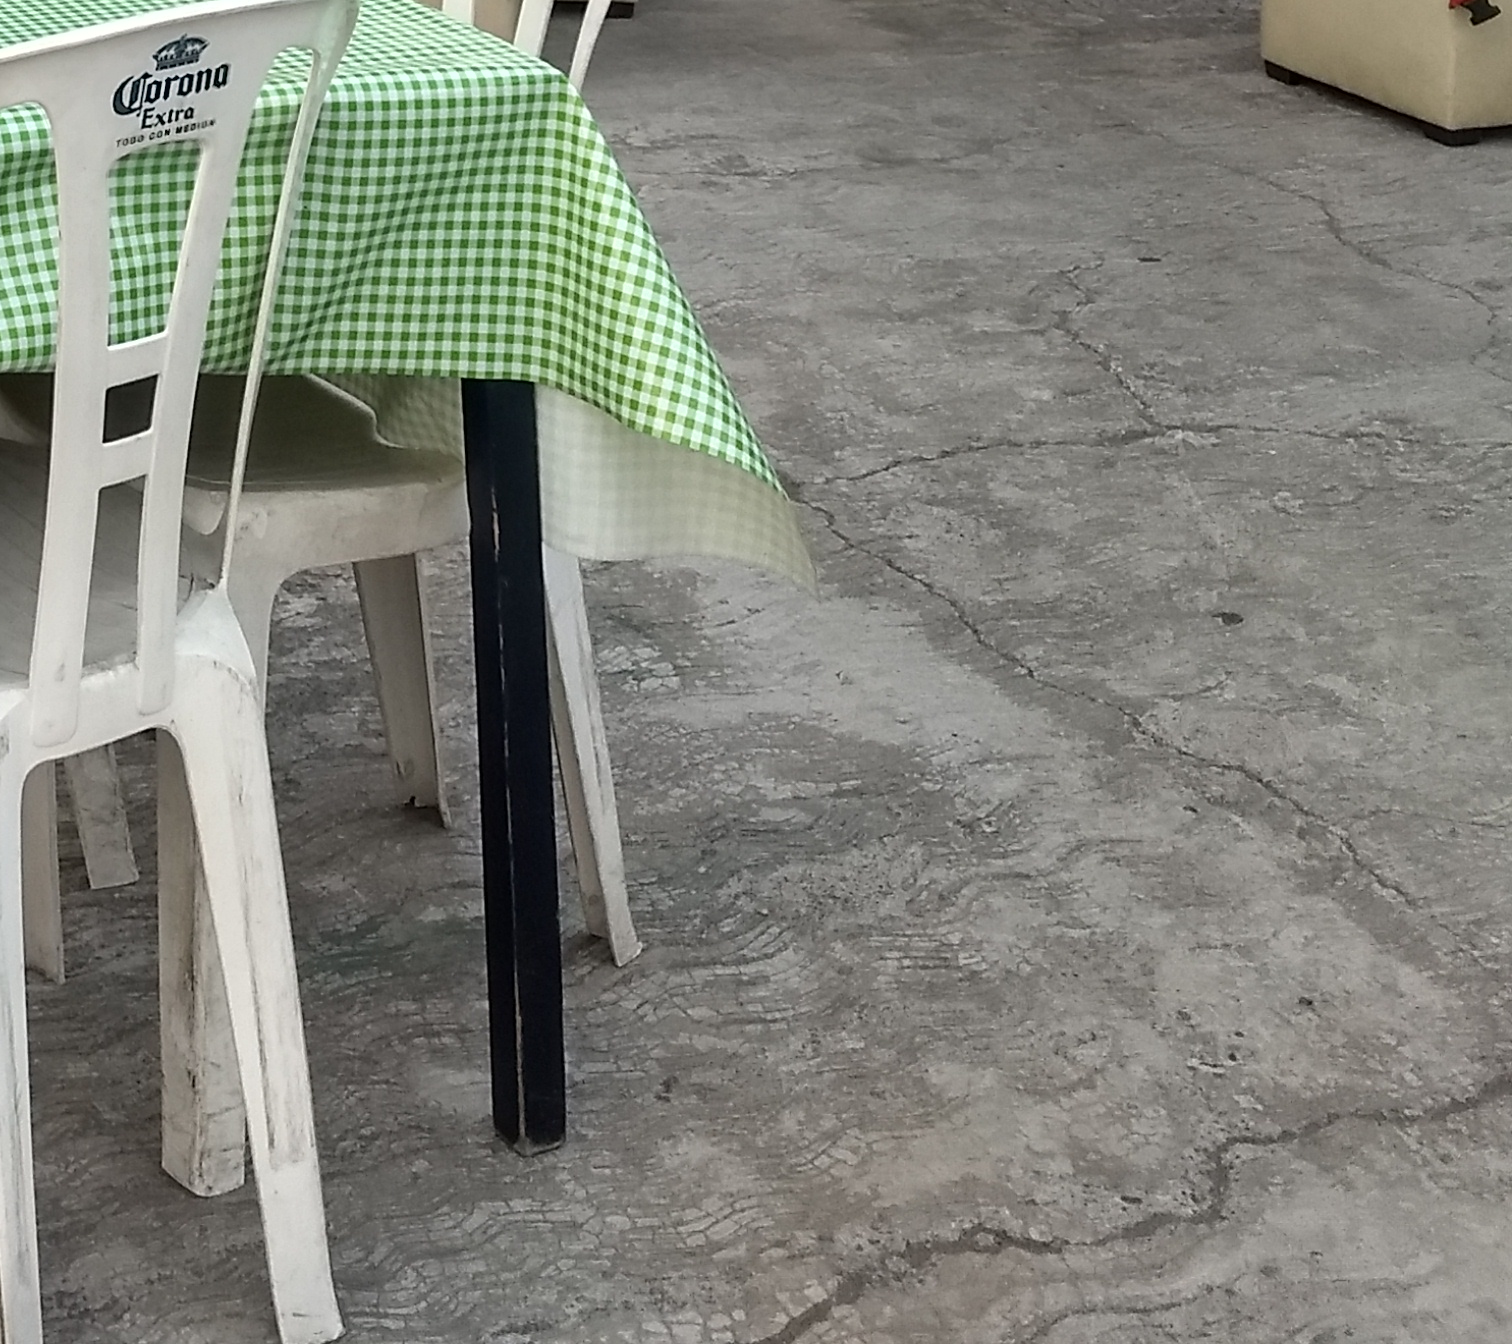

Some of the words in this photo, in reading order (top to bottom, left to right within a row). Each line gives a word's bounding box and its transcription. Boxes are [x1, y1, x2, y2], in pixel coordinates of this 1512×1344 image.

[112, 63, 230, 116] Corona
[140, 106, 195, 130] Extra
[115, 135, 145, 148] TODO
[149, 128, 171, 141] CON
